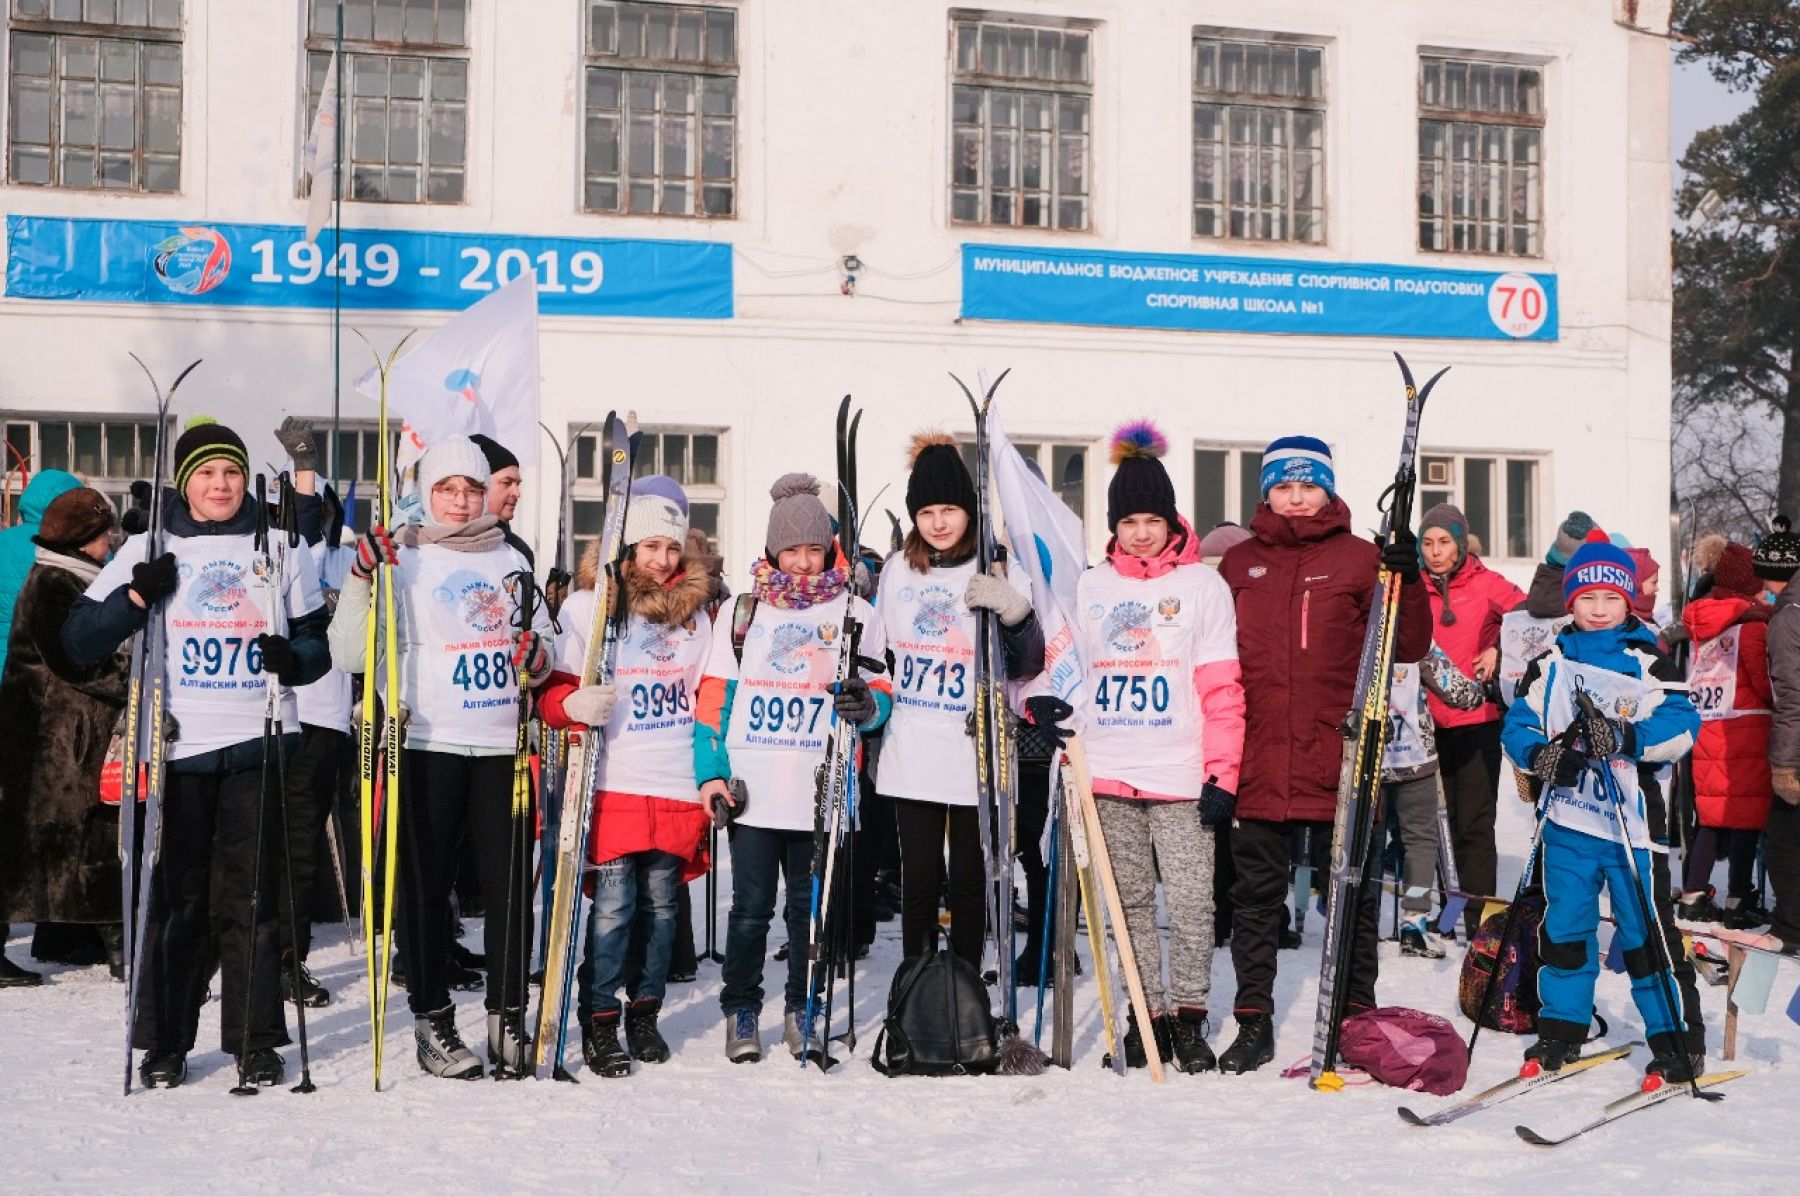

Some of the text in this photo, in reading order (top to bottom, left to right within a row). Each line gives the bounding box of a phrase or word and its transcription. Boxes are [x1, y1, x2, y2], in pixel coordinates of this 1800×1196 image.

[251, 239, 399, 287] 1949
[459, 247, 604, 294] 2019
[974, 257, 1485, 296] МУНИЦИПАЛЬНОЕ БЮДЖЕТНОЕ УЧРЕЖДЕНИЕ СПОРТИВНОЙ ПОДГОТОВКИ
[1146, 293, 1324, 315] СПОРТИВНАЯ ШКОЛА №1
[1496, 287, 1542, 321] 70
[1511, 323, 1528, 332] ЛЕТ
[202, 560, 242, 572] ЛЫЖНЯ
[1577, 564, 1634, 592] RUSSIA
[202, 601, 240, 612] РОССИИ
[173, 620, 206, 628] ЛЫЖНЯ
[209, 620, 247, 629] РОССИИ
[254, 620, 268, 628] 201
[182, 637, 264, 676] 9976
[771, 661, 806, 674] РОССИИ
[179, 677, 237, 689] Алтайский
[776, 680, 811, 690] РОССИИ
[901, 654, 966, 699] 9713
[1095, 675, 1170, 712] 4750
[749, 694, 825, 734] 9997
[151, 688, 162, 796] DYNAMIC
[363, 719, 372, 780] NORDWAY
[388, 716, 397, 778] NORDWAY
[745, 733, 797, 747] Алтайский
